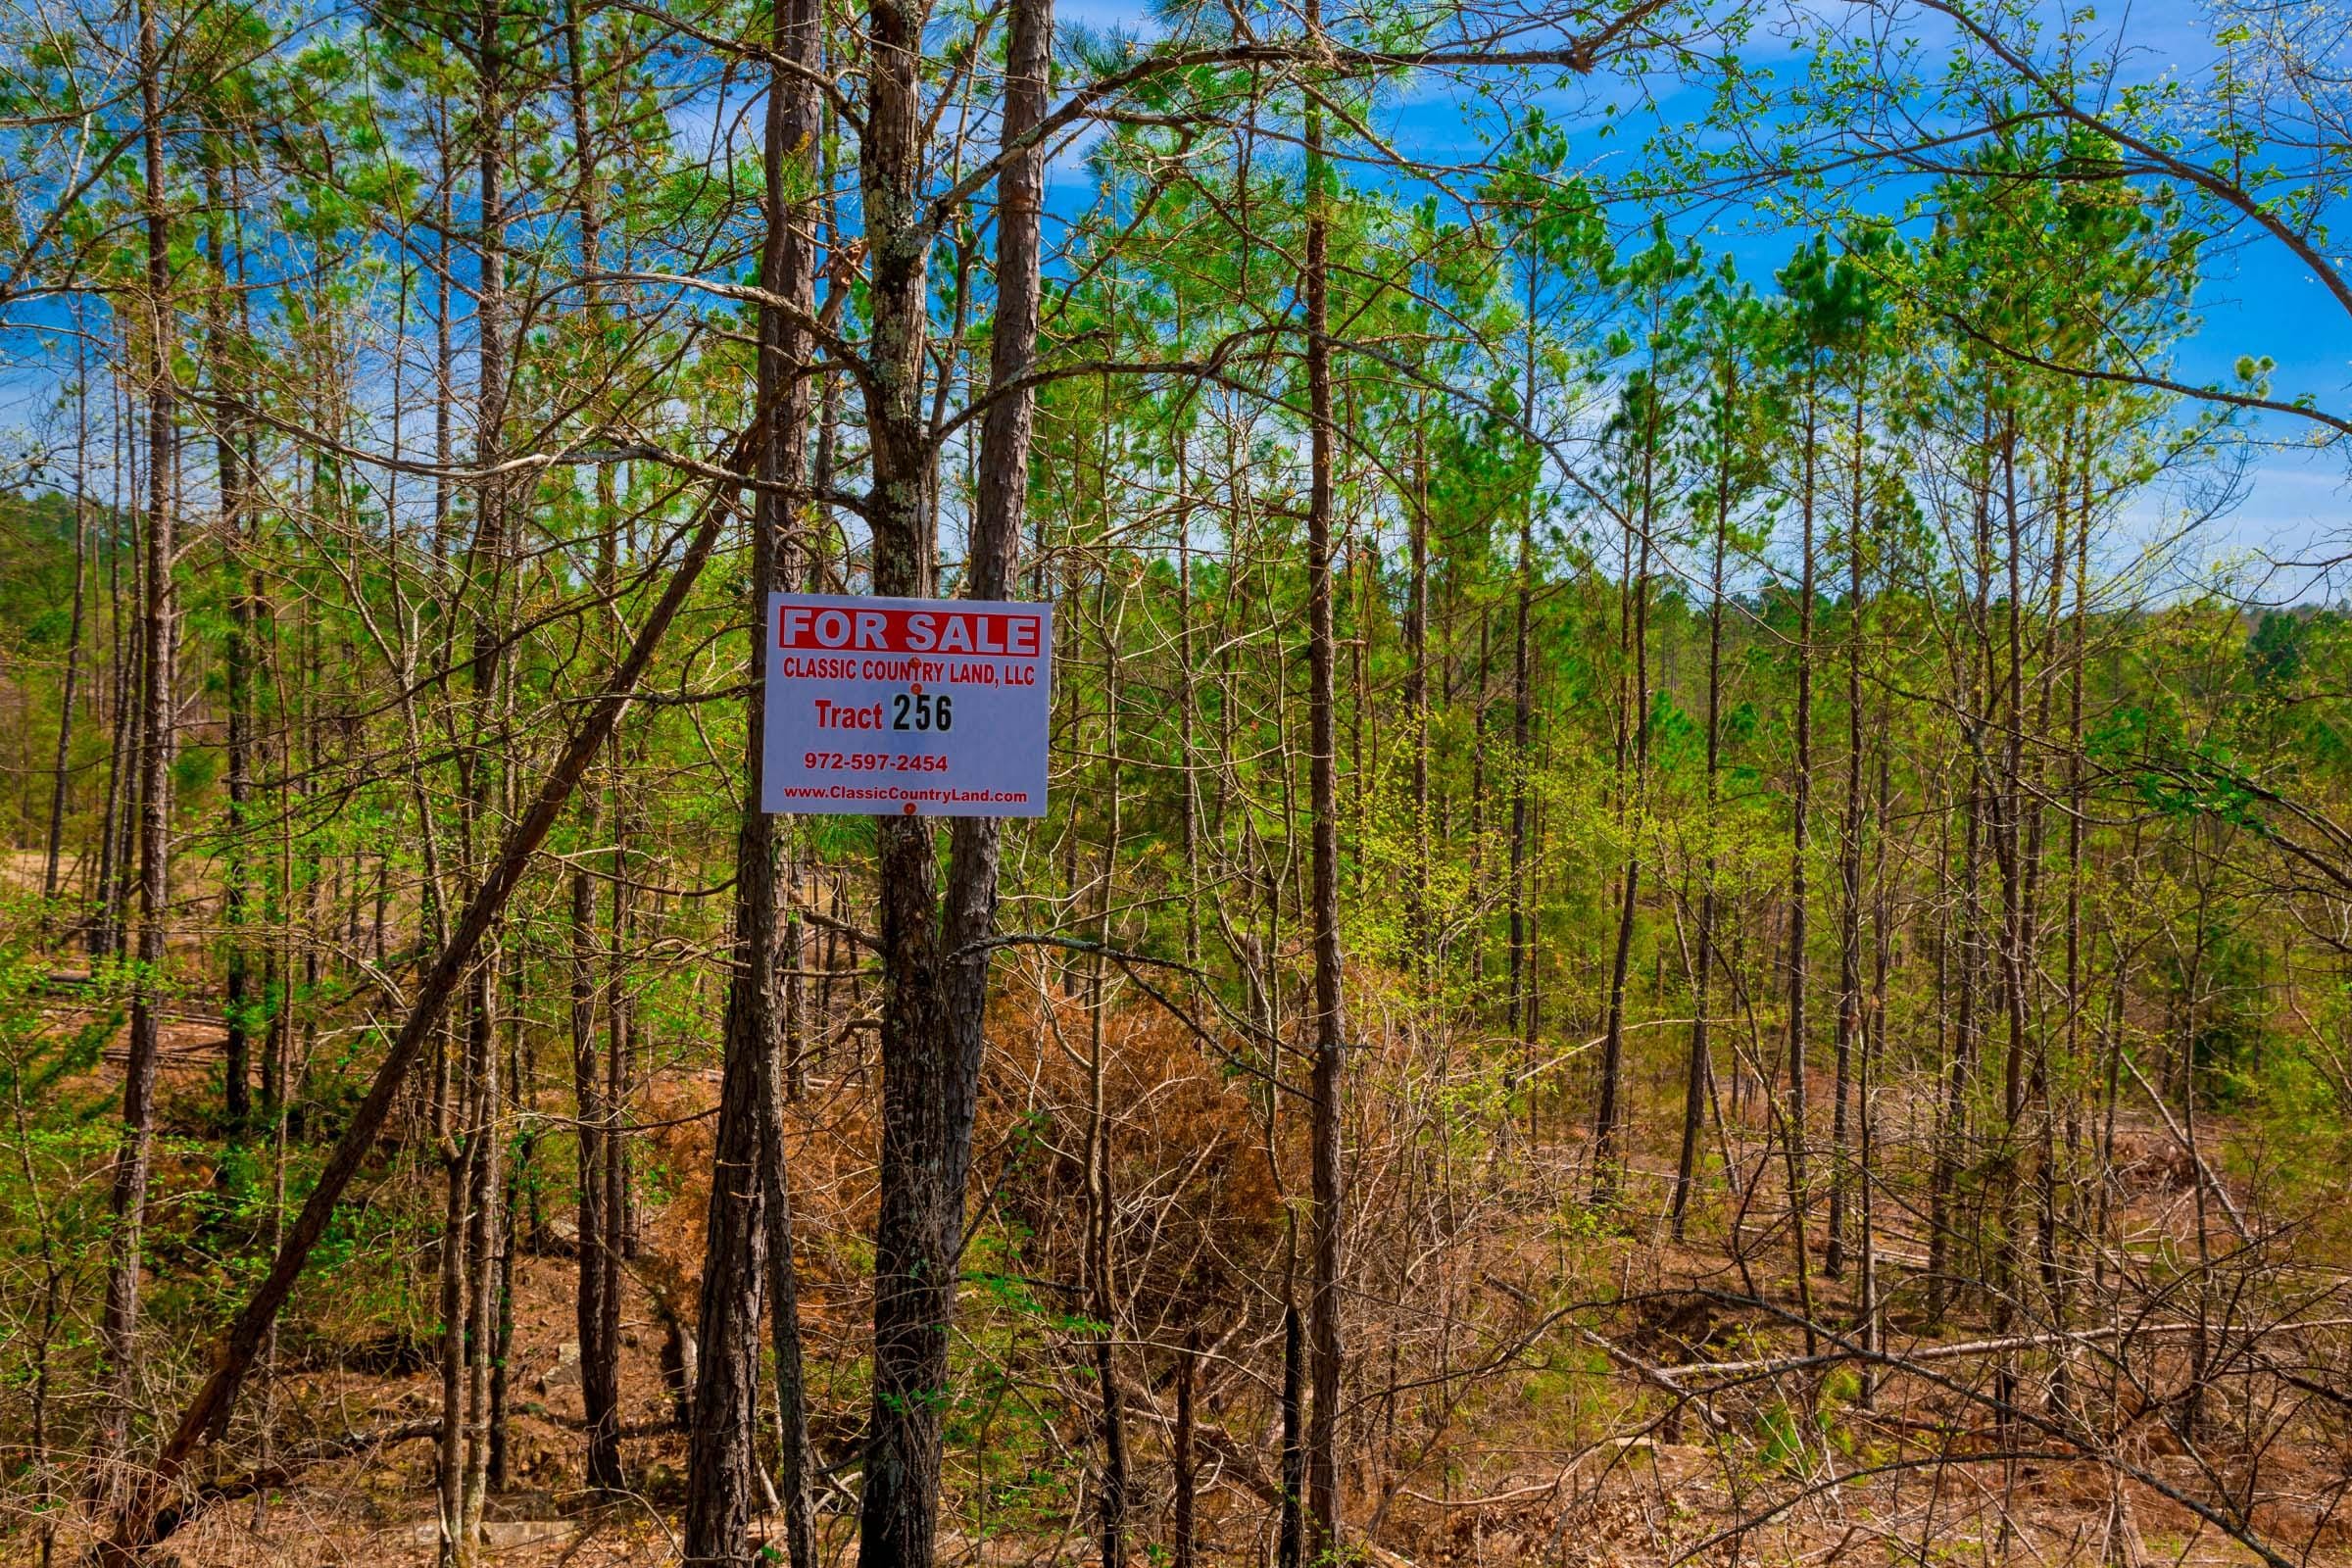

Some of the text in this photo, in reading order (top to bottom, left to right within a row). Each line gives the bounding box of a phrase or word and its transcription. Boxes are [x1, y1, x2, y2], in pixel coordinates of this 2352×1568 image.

[783, 609, 1036, 654] FOR SALE
[783, 657, 857, 679] CLASSIC
[950, 663, 999, 688] LAND,
[1004, 665, 1035, 685] LLC
[814, 694, 952, 731] Tract 256
[804, 753, 948, 771] 972-597-2454
[784, 785, 1027, 803] www.ClassicCountryLand.com
